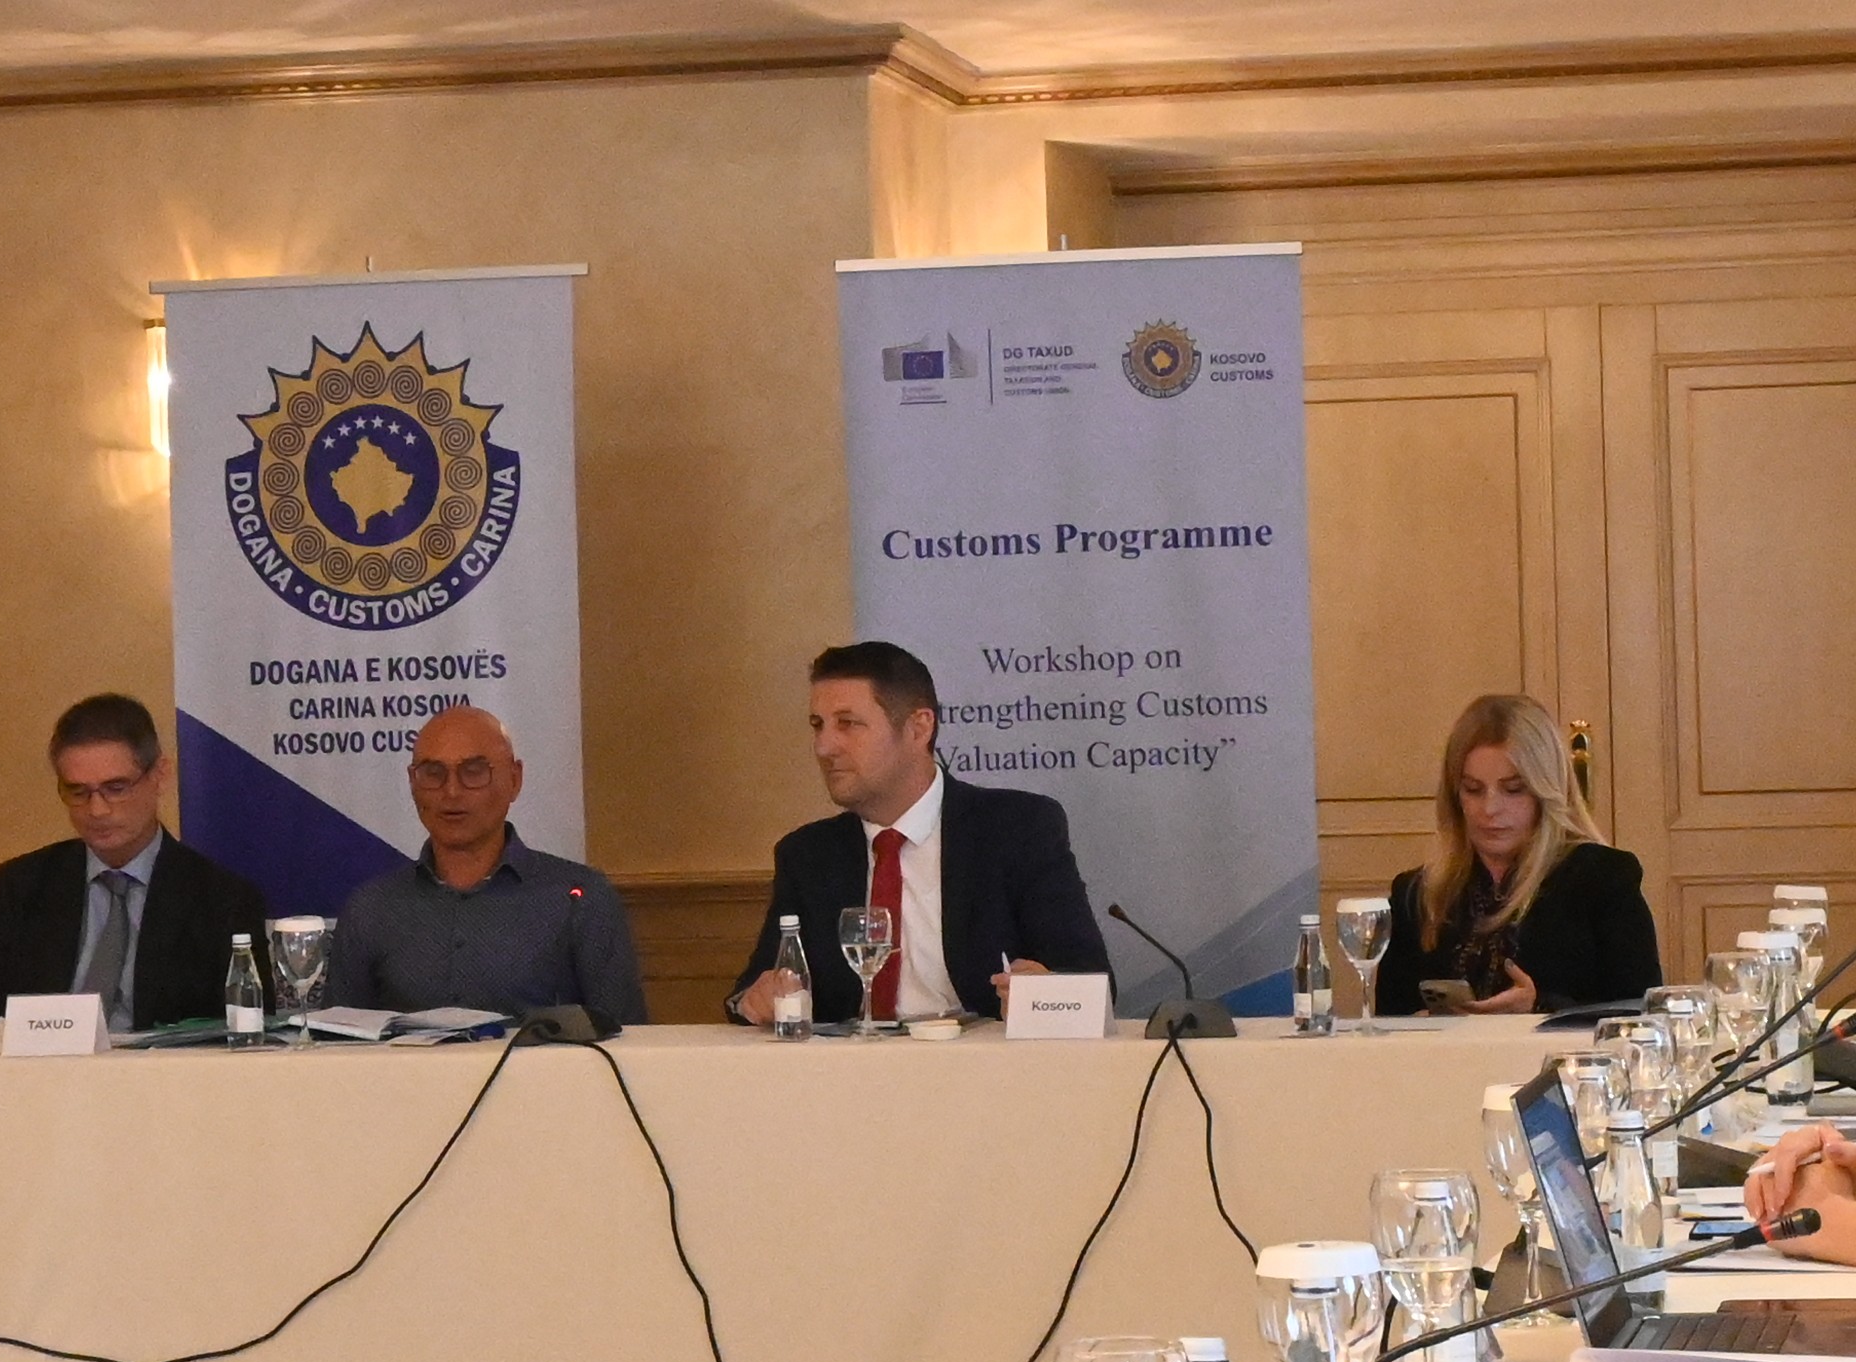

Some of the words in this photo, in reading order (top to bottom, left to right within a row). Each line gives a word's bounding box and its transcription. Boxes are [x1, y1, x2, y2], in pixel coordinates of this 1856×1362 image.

[1003, 347, 1024, 360] DG
[1027, 345, 1074, 359] TAXUD
[1210, 352, 1266, 365] KOSOVO
[1210, 369, 1275, 382] CUSTOMS
[229, 471, 293, 592] DOGANA
[309, 582, 449, 625] CUSTOMS
[461, 465, 517, 577] CARINA
[882, 529, 1041, 560] Customs
[1055, 523, 1273, 560] Programme
[250, 659, 359, 685] DOGANA
[366, 658, 382, 682] E
[388, 649, 507, 682] KOSOVËS
[982, 644, 1135, 678] Workshop
[1145, 649, 1181, 669] on
[289, 697, 376, 720] CARINA
[938, 692, 1127, 730] trengthening
[1137, 691, 1268, 718] Customs
[273, 731, 365, 755] KOSOVO
[935, 743, 1075, 772] Valuation
[1031, 1000, 1082, 1011] Kosovo
[27, 1019, 74, 1030] TAXUD
